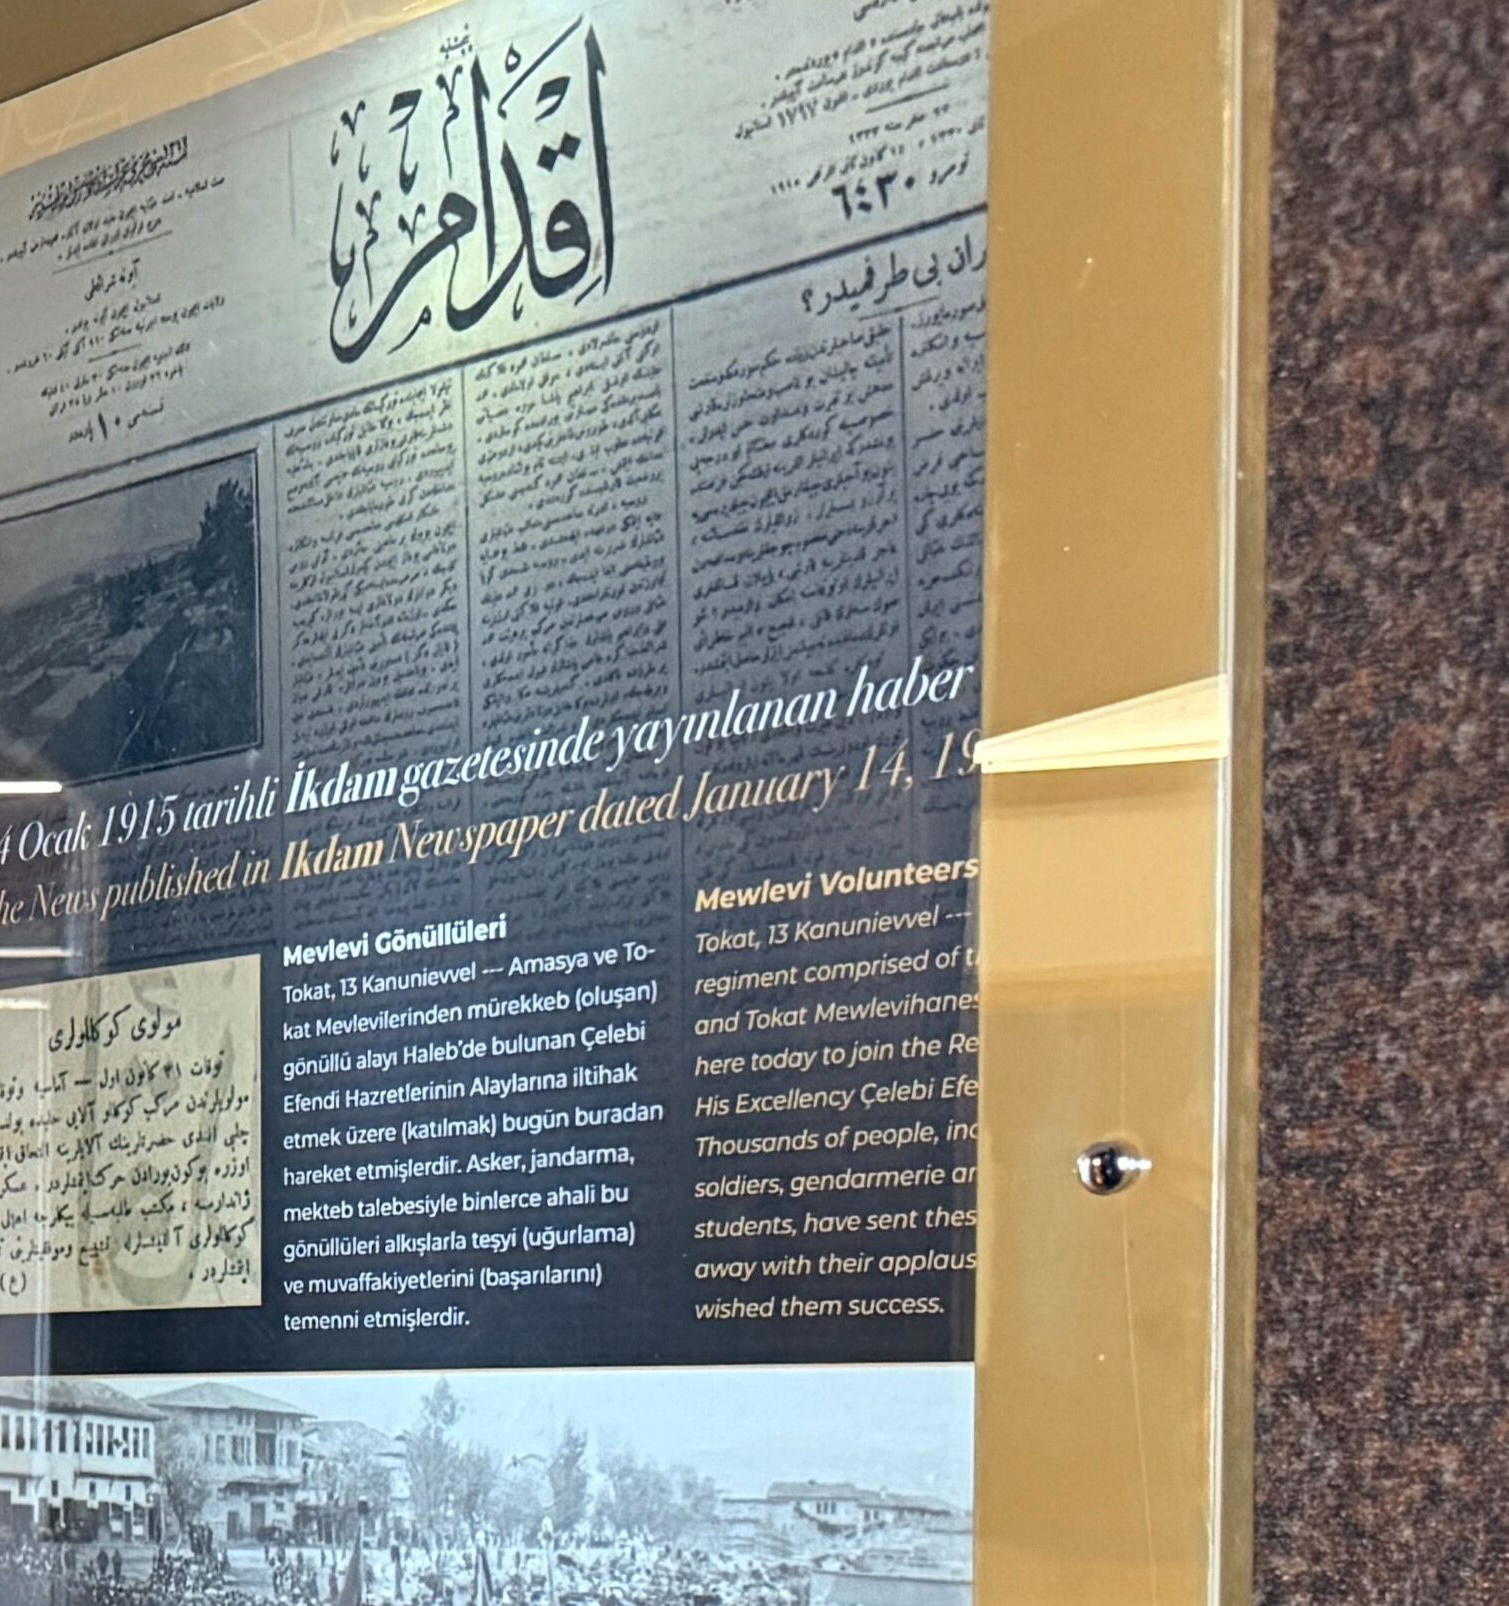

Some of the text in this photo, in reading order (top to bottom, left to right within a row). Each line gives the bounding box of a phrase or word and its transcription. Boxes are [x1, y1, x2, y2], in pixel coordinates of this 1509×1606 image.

[19, 811, 92, 862] Ocak
[101, 794, 177, 848] 1915
[183, 776, 280, 832] tarihli
[285, 760, 399, 814] İkdam
[398, 715, 604, 808] gazetesinde
[605, 688, 835, 771] yayınlanan
[846, 655, 974, 717] haber
[29, 881, 99, 922] News
[101, 859, 236, 922] published
[243, 854, 270, 888] in
[281, 834, 384, 882] Ikdam
[387, 806, 574, 865] Newspaper
[579, 774, 683, 834] dated
[683, 763, 846, 821] January
[854, 743, 914, 791] 14,
[695, 857, 979, 913] Mewlevi Volunteers
[283, 913, 507, 968] Mevlevi Gönüllüleri
[695, 905, 940, 954] Tokat, 13 Kanunievvel
[282, 941, 655, 1004] Tokat, 13 Kanunievvel Amasya ve To-
[695, 966, 798, 997] regiment
[803, 950, 929, 987] comprised
[935, 946, 960, 969] of
[283, 980, 657, 1040] kat Mevlevilerinden mürekkeb (oluşan)
[695, 1012, 739, 1036] and
[746, 1006, 807, 1031] Tokat
[283, 1052, 351, 1081] gönüllü
[356, 1050, 399, 1073] alayı
[492, 1029, 575, 1056] bulunan
[581, 1022, 646, 1051] Çelebi
[695, 1055, 745, 1078] here
[751, 1050, 818, 1073] today
[822, 1046, 845, 1065] to
[848, 1039, 895, 1068] join
[901, 1035, 942, 1057] the
[283, 1062, 637, 1114] Efendi Hazretlerinin Alaylarına iltihak
[695, 1095, 729, 1117] His
[735, 1088, 856, 1114] Excellency
[860, 1076, 935, 1110] Çelebi
[283, 1101, 663, 1151] etmek üzere (katılmak) bugün buradan
[695, 1129, 819, 1157] Thousands
[825, 1125, 850, 1149] of
[853, 1121, 939, 1151] people,
[283, 1144, 635, 1186] hareket etmişlerdir. Asker, jandarma,
[695, 1164, 945, 1198] soldiers, gendarmerie
[283, 1183, 629, 1222] mekteb talebesiyle binlerce ahali bu
[695, 1206, 977, 1238] students, have sent thes
[283, 1221, 635, 1262] gönüllüleri alkışlarla teşyi (uğurlama)
[284, 1262, 602, 1295] ve muvaffakiyetlerini (başarılarını)
[695, 1259, 756, 1282] away
[762, 1254, 812, 1277] with
[818, 1252, 874, 1275] their
[284, 1306, 470, 1333] temenni etmişlerdir.
[695, 1295, 944, 1320] wished them success.
